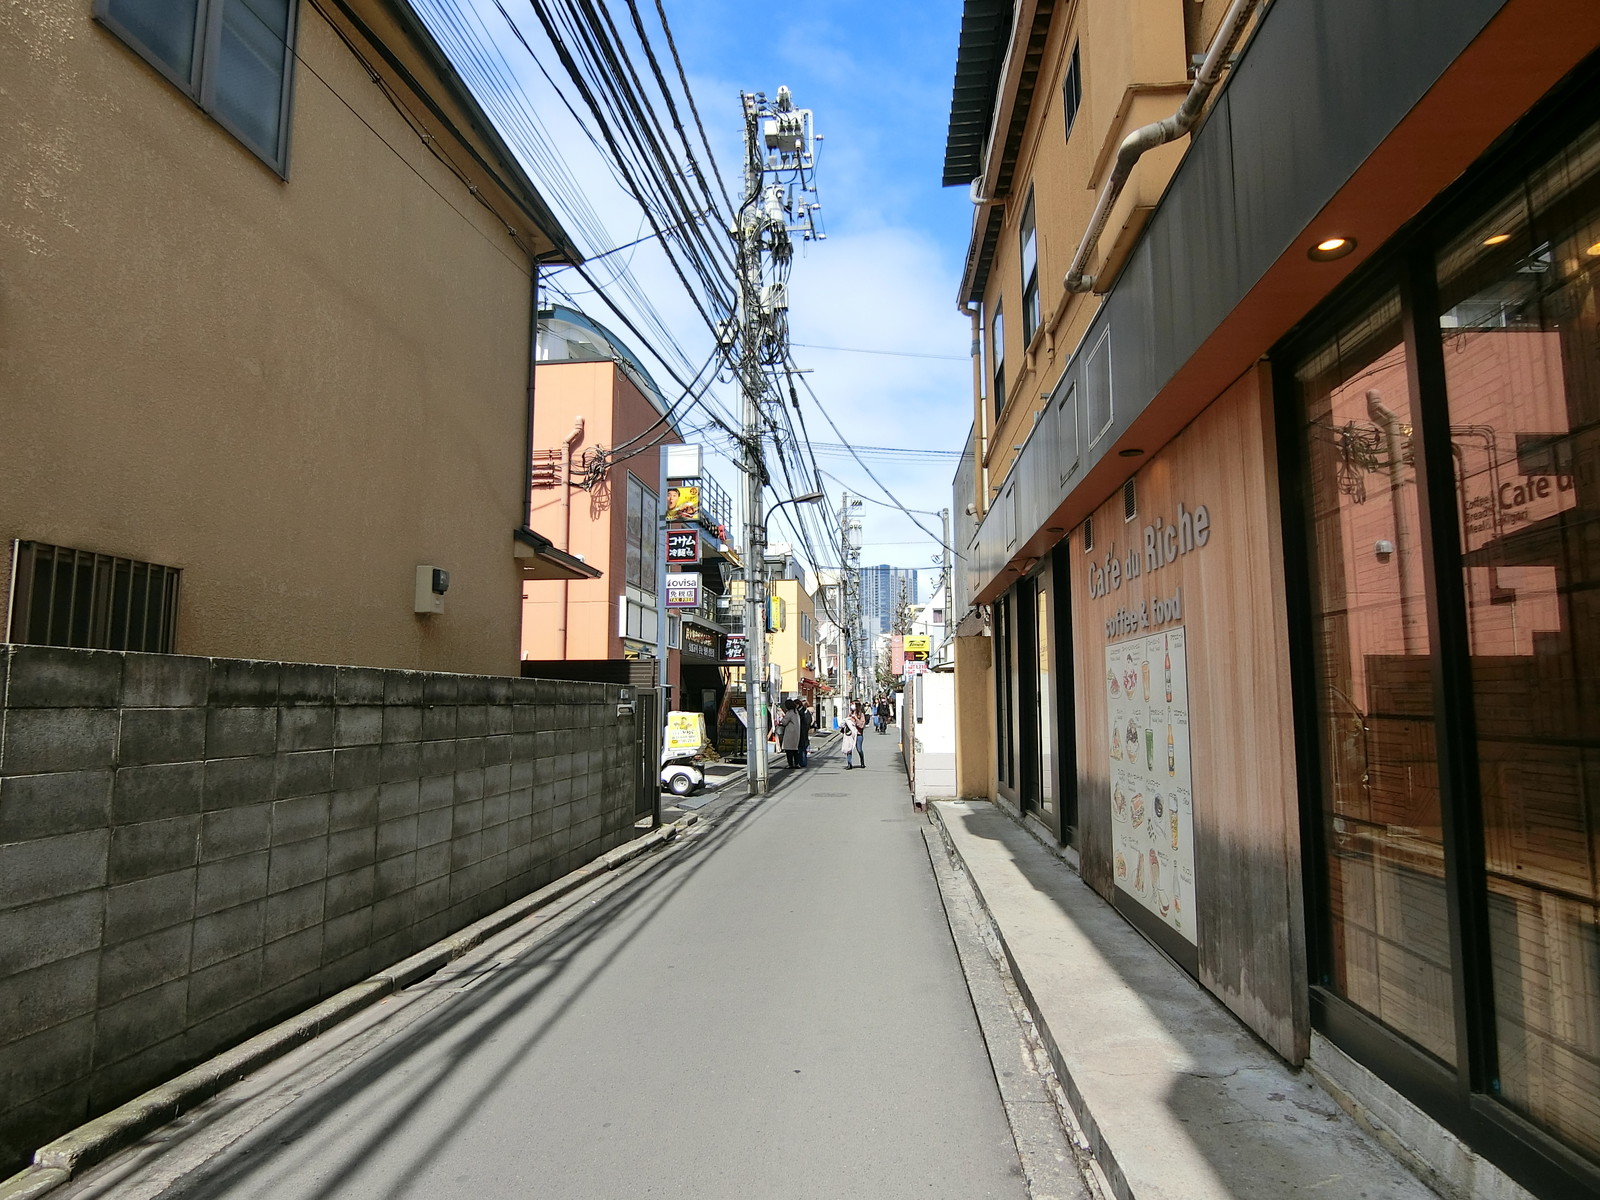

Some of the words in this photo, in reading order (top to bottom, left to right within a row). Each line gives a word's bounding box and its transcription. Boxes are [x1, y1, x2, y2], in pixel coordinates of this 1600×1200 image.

[668, 535, 696, 548] コサム
[1088, 542, 1121, 599] Café
[1125, 549, 1140, 581] du
[1144, 502, 1210, 573] Riche
[1105, 607, 1138, 638] coffee
[1140, 599, 1149, 629] &
[1151, 586, 1182, 626] food
